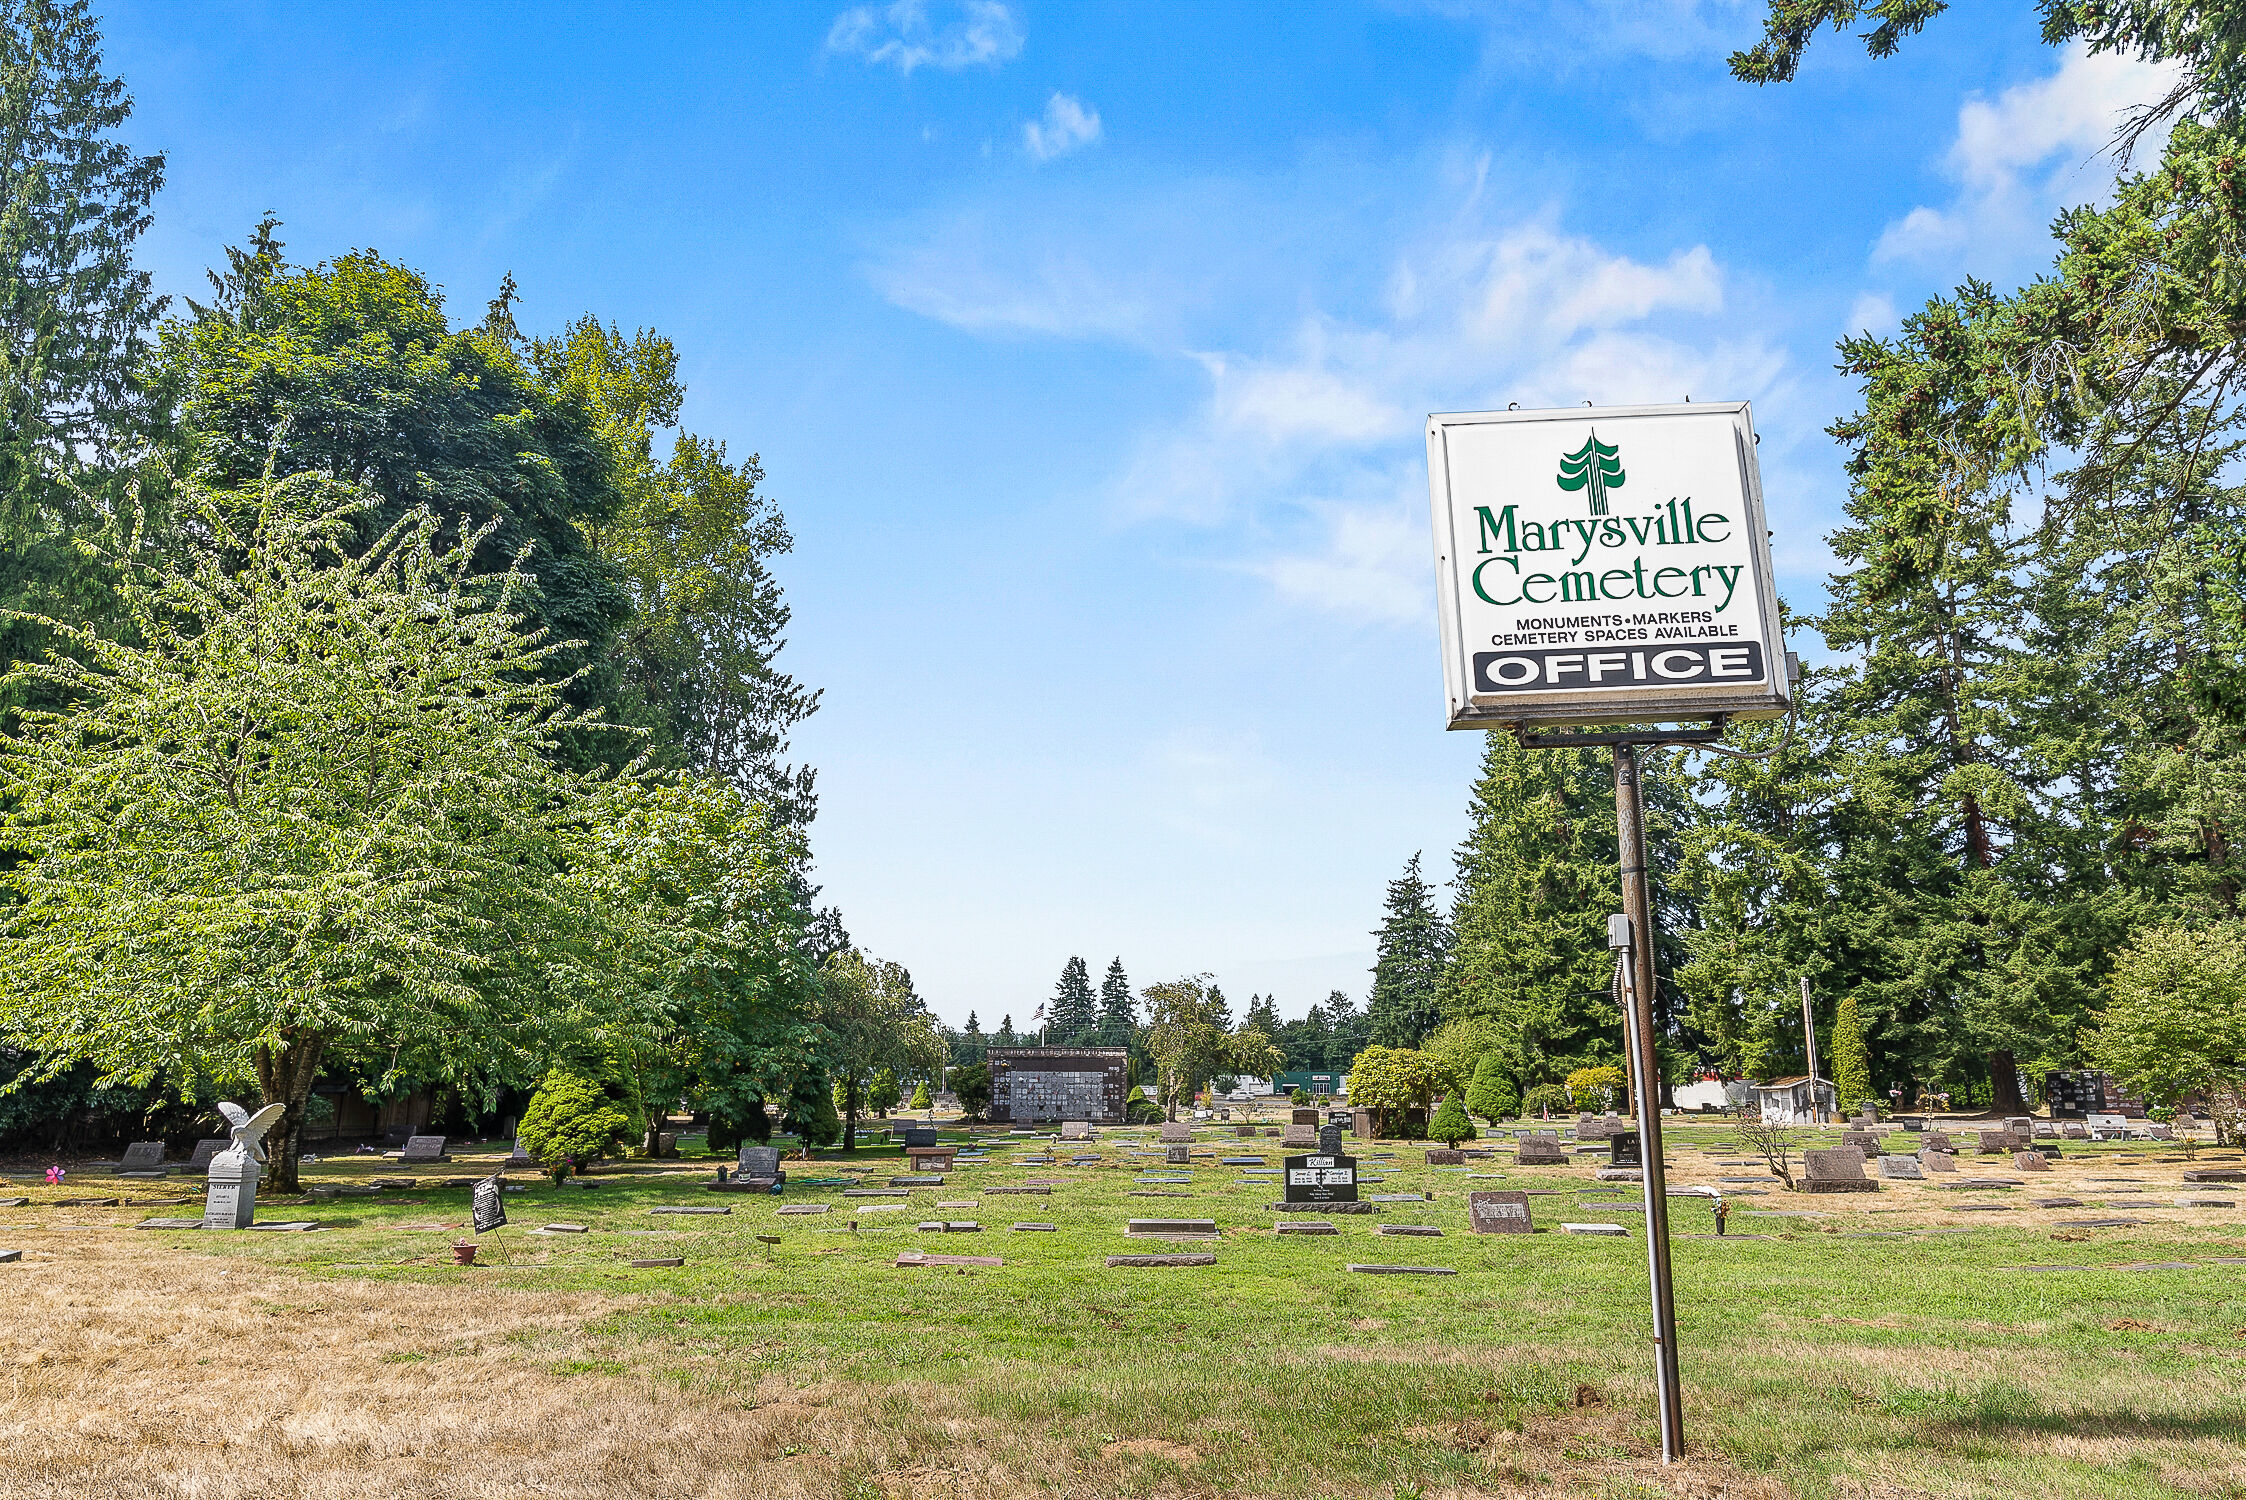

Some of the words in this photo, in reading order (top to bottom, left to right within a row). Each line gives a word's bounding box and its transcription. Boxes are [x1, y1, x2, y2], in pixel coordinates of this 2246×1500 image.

[1473, 497, 1731, 566] Marysville
[1472, 556, 1745, 613] Cemetery
[1491, 630, 1578, 646] CEMETERY
[1584, 628, 1648, 643] SPACES
[1654, 624, 1739, 640] AVAILABLE
[1485, 647, 1753, 686] OFFICE
